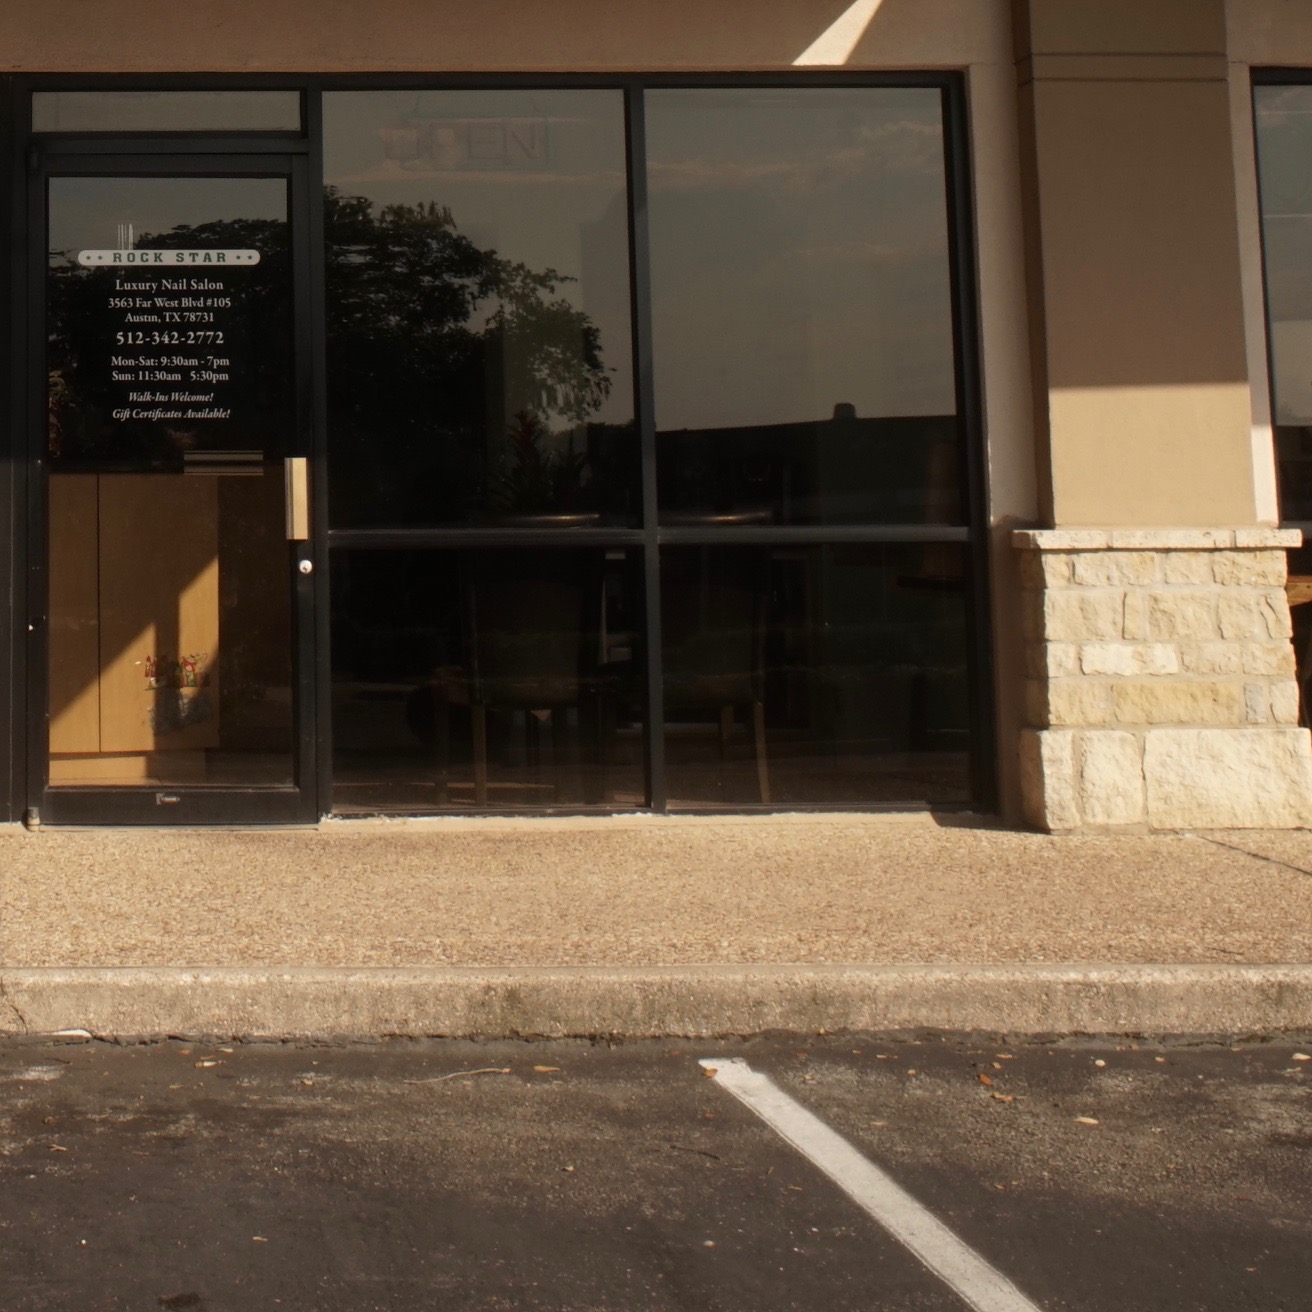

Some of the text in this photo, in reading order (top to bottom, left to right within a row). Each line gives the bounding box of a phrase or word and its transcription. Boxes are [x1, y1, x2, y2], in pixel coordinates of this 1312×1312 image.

[112, 252, 227, 263] ROCK STAR
[115, 279, 224, 294] Luxury Nail Salon
[107, 297, 231, 309] 3563 Far West Blvd #105
[124, 312, 214, 324] Austin, TX 78731
[116, 331, 224, 345] 512-342-2772
[111, 356, 158, 367] Mon-Sat:
[160, 356, 199, 367] 9:30am
[206, 356, 230, 369] 7pm
[112, 371, 229, 383] Sun: 11:30am 5:30pm
[128, 392, 214, 402] Walk-Ins Welcome!
[112, 408, 231, 421] Gift Certificates Available!
